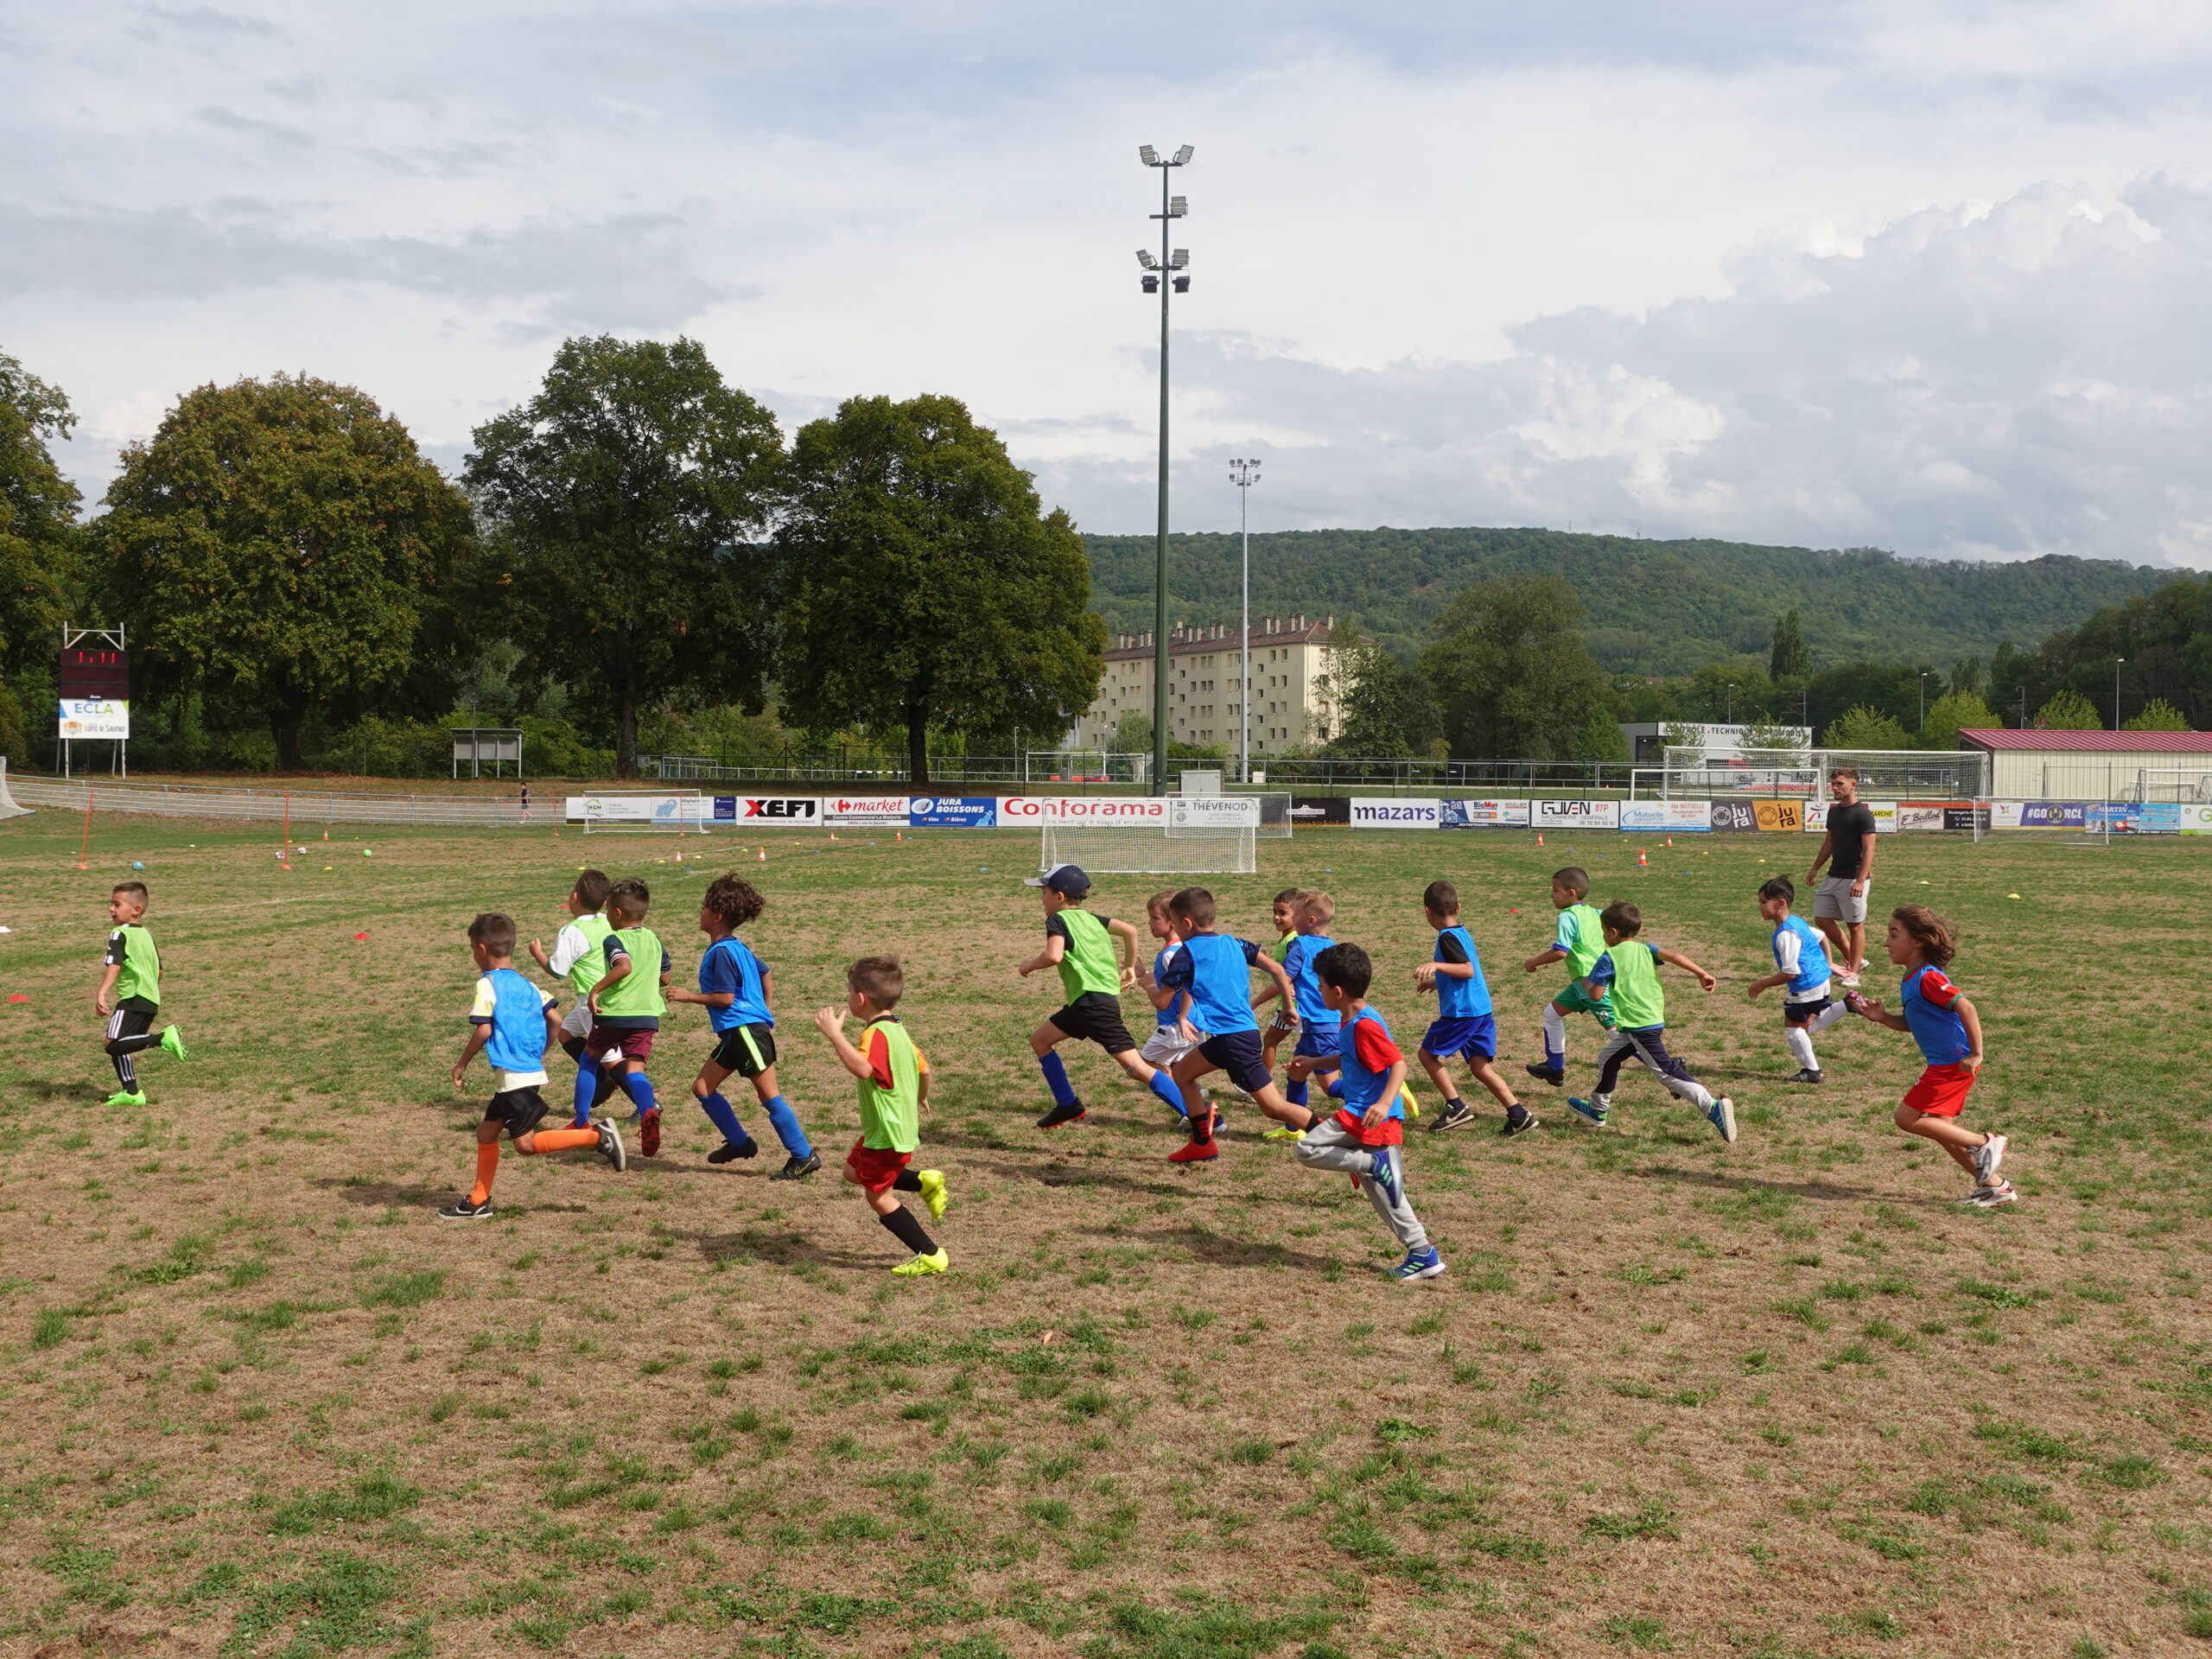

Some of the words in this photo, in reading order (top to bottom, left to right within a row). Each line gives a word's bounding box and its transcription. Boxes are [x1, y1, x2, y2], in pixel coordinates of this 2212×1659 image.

[74, 702, 114, 715] ECLA
[744, 799, 816, 818] XEFI
[853, 798, 904, 813] market
[1004, 798, 1163, 817] Conforama
[1192, 800, 1248, 810] THÉVENOD
[1731, 804, 1747, 819] ju
[1777, 804, 1793, 818] ju
[1354, 806, 1435, 821] mazars
[2027, 808, 2048, 819] #GO
[2063, 808, 2083, 819] RCL
[1732, 817, 1751, 829] ra
[1779, 816, 1796, 828] ra
